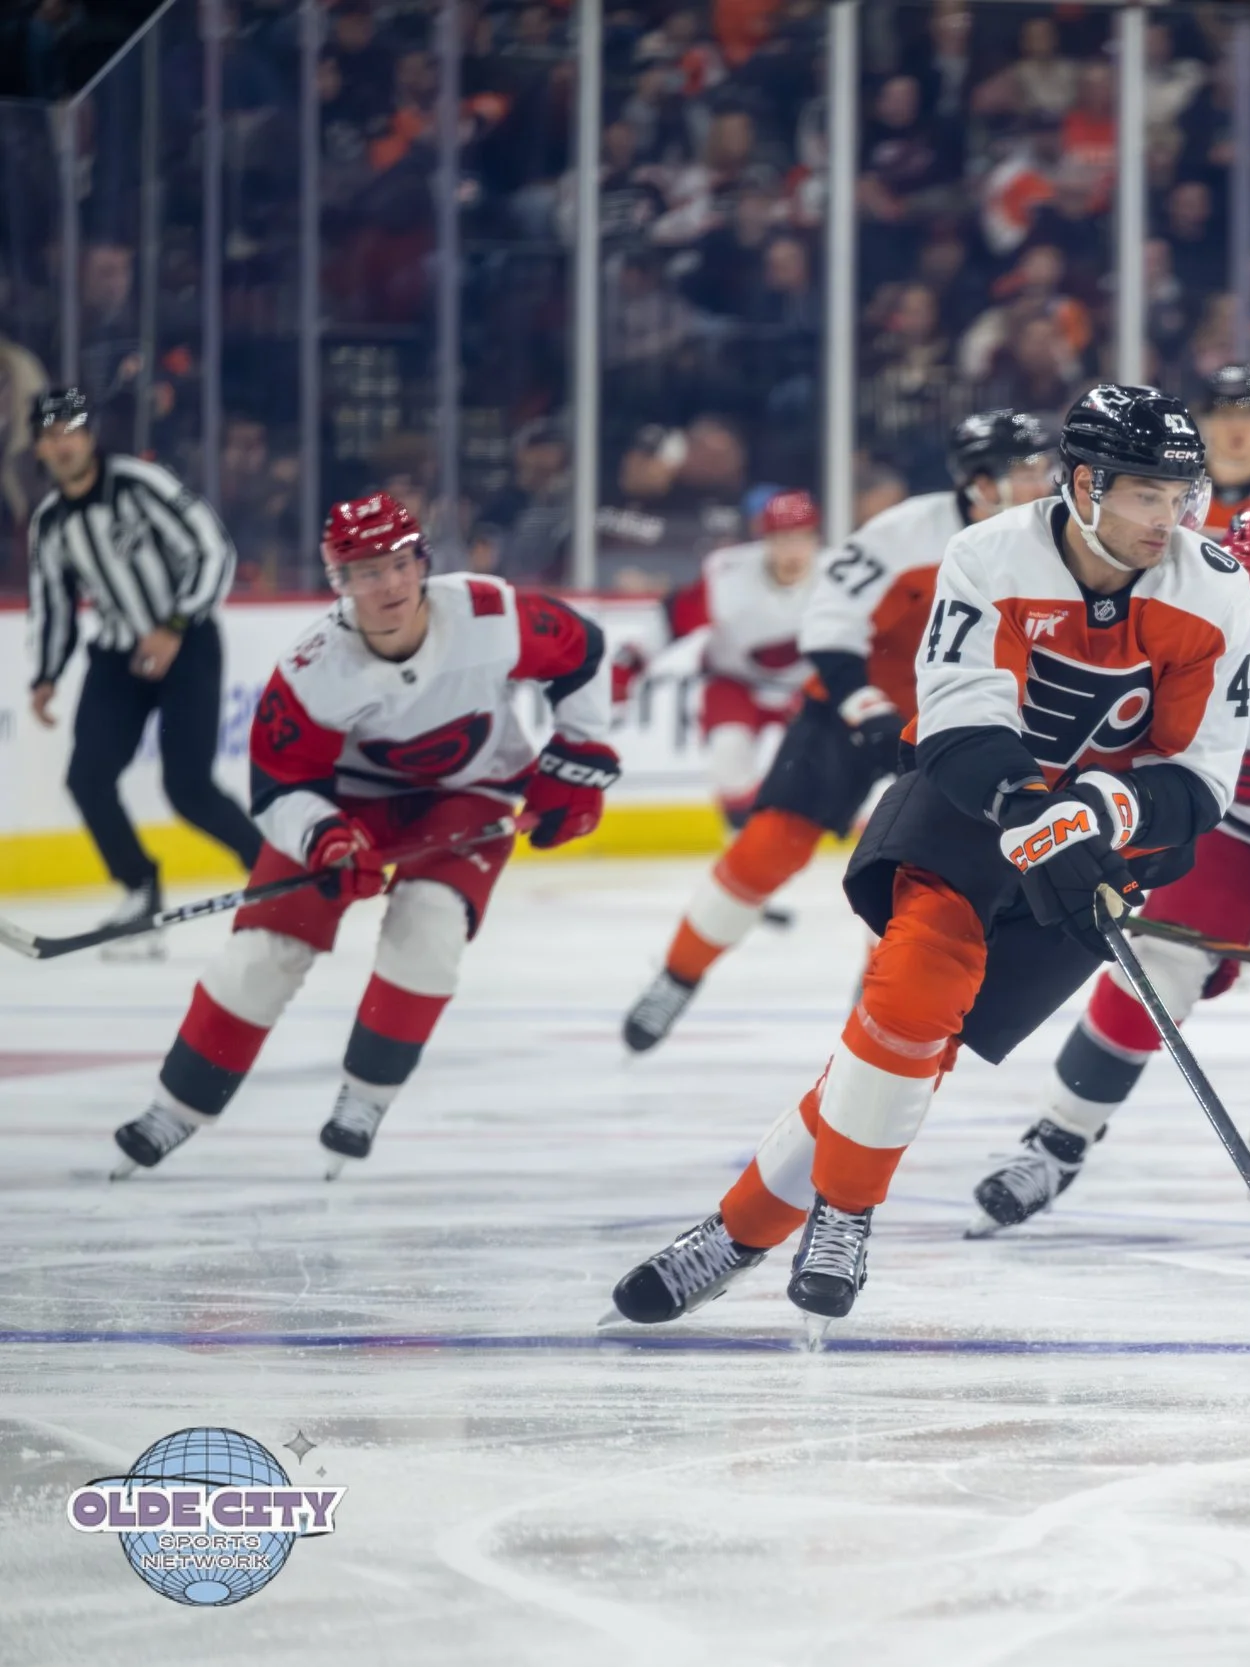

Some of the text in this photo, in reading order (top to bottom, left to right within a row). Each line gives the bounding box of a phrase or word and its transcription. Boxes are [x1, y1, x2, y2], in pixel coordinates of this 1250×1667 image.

[1163, 412, 1196, 436] 47
[1163, 449, 1198, 461] CCM
[827, 542, 886, 597] 27
[926, 599, 983, 664] 47
[256, 688, 302, 754] 53
[1009, 809, 1091, 873] CCM
